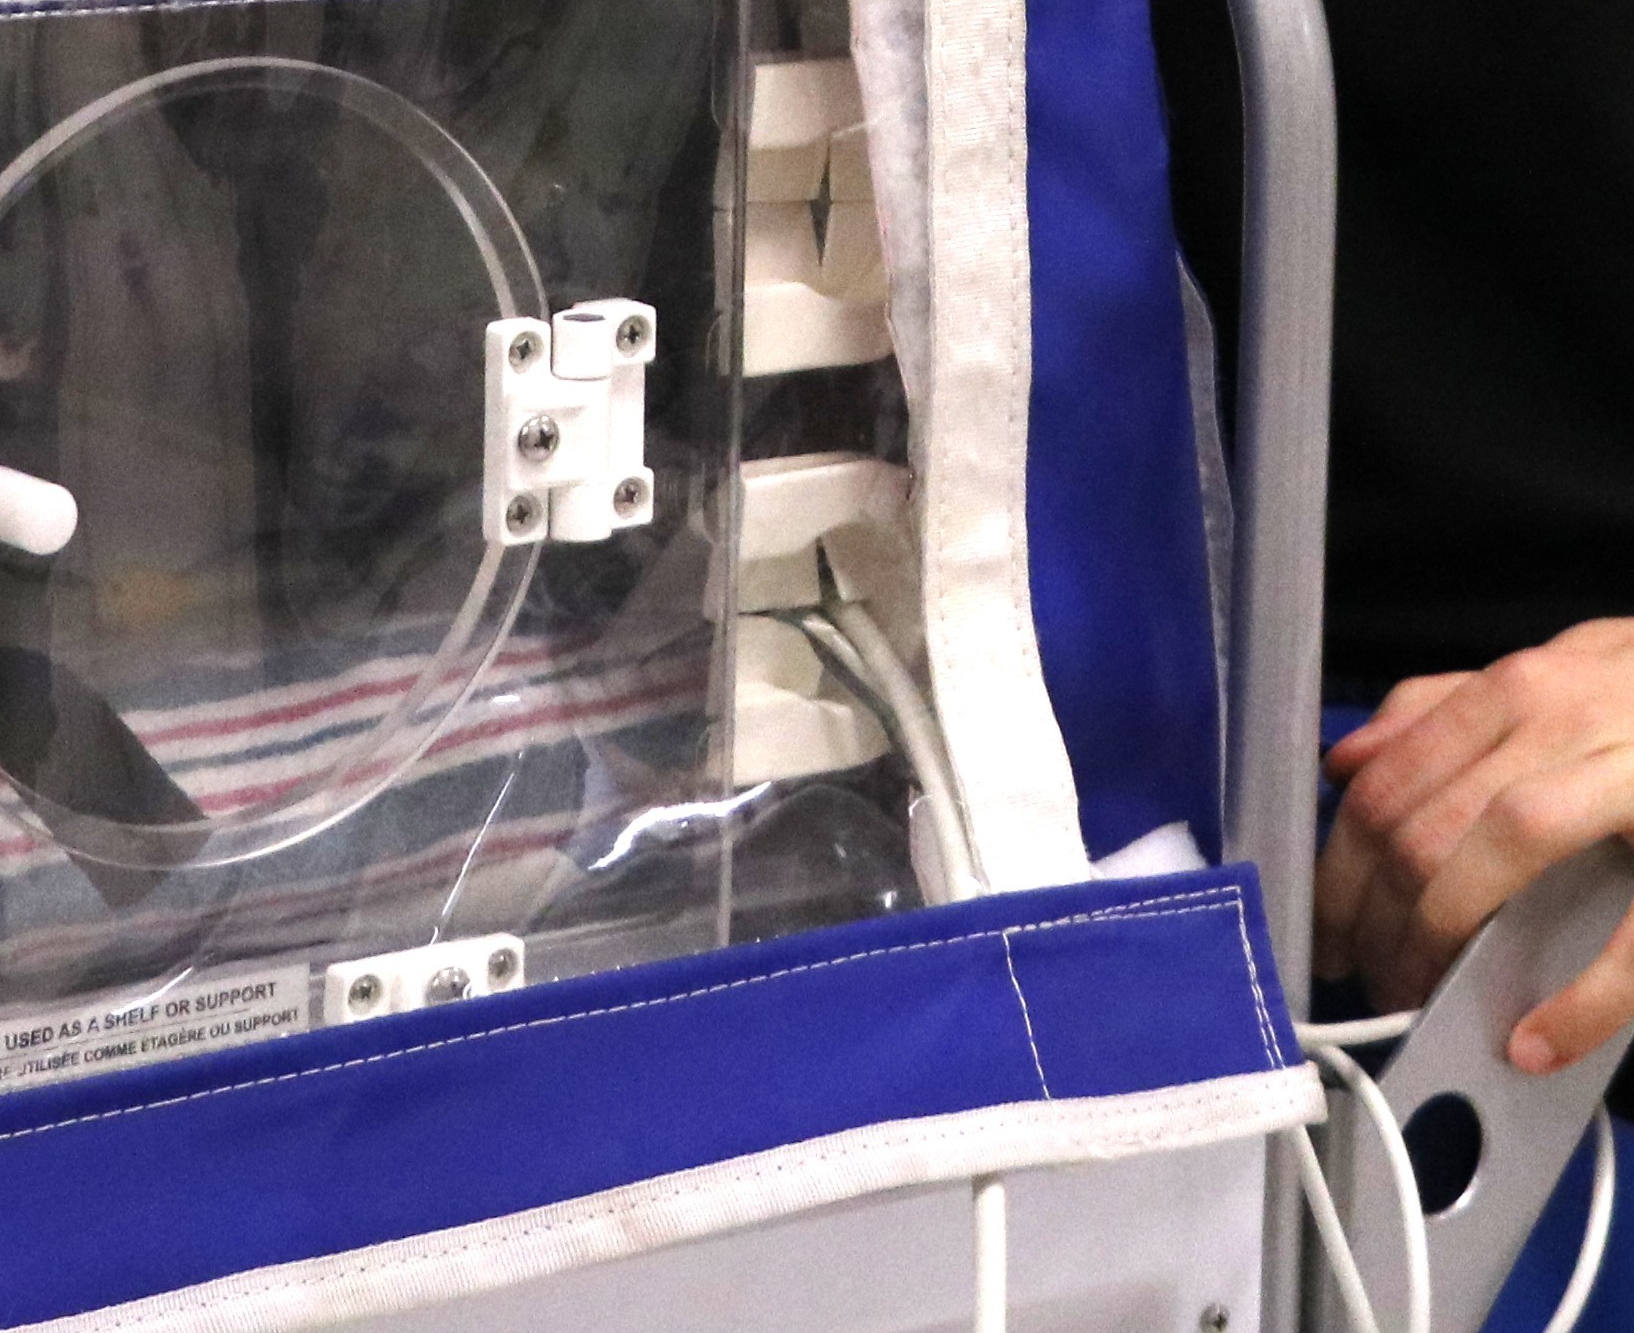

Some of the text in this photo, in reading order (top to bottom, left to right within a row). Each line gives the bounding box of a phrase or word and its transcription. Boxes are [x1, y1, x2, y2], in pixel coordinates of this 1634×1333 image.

[4, 1026, 55, 1052] USED
[58, 1019, 83, 1039] AS
[87, 1016, 100, 1033] A
[103, 1004, 160, 1031] SHELF
[166, 1000, 191, 1018] OR
[195, 982, 277, 1013] SUPPORT
[84, 1039, 137, 1063] COMME
[209, 1021, 231, 1039] OU
[234, 1007, 298, 1034] SUPPORT
